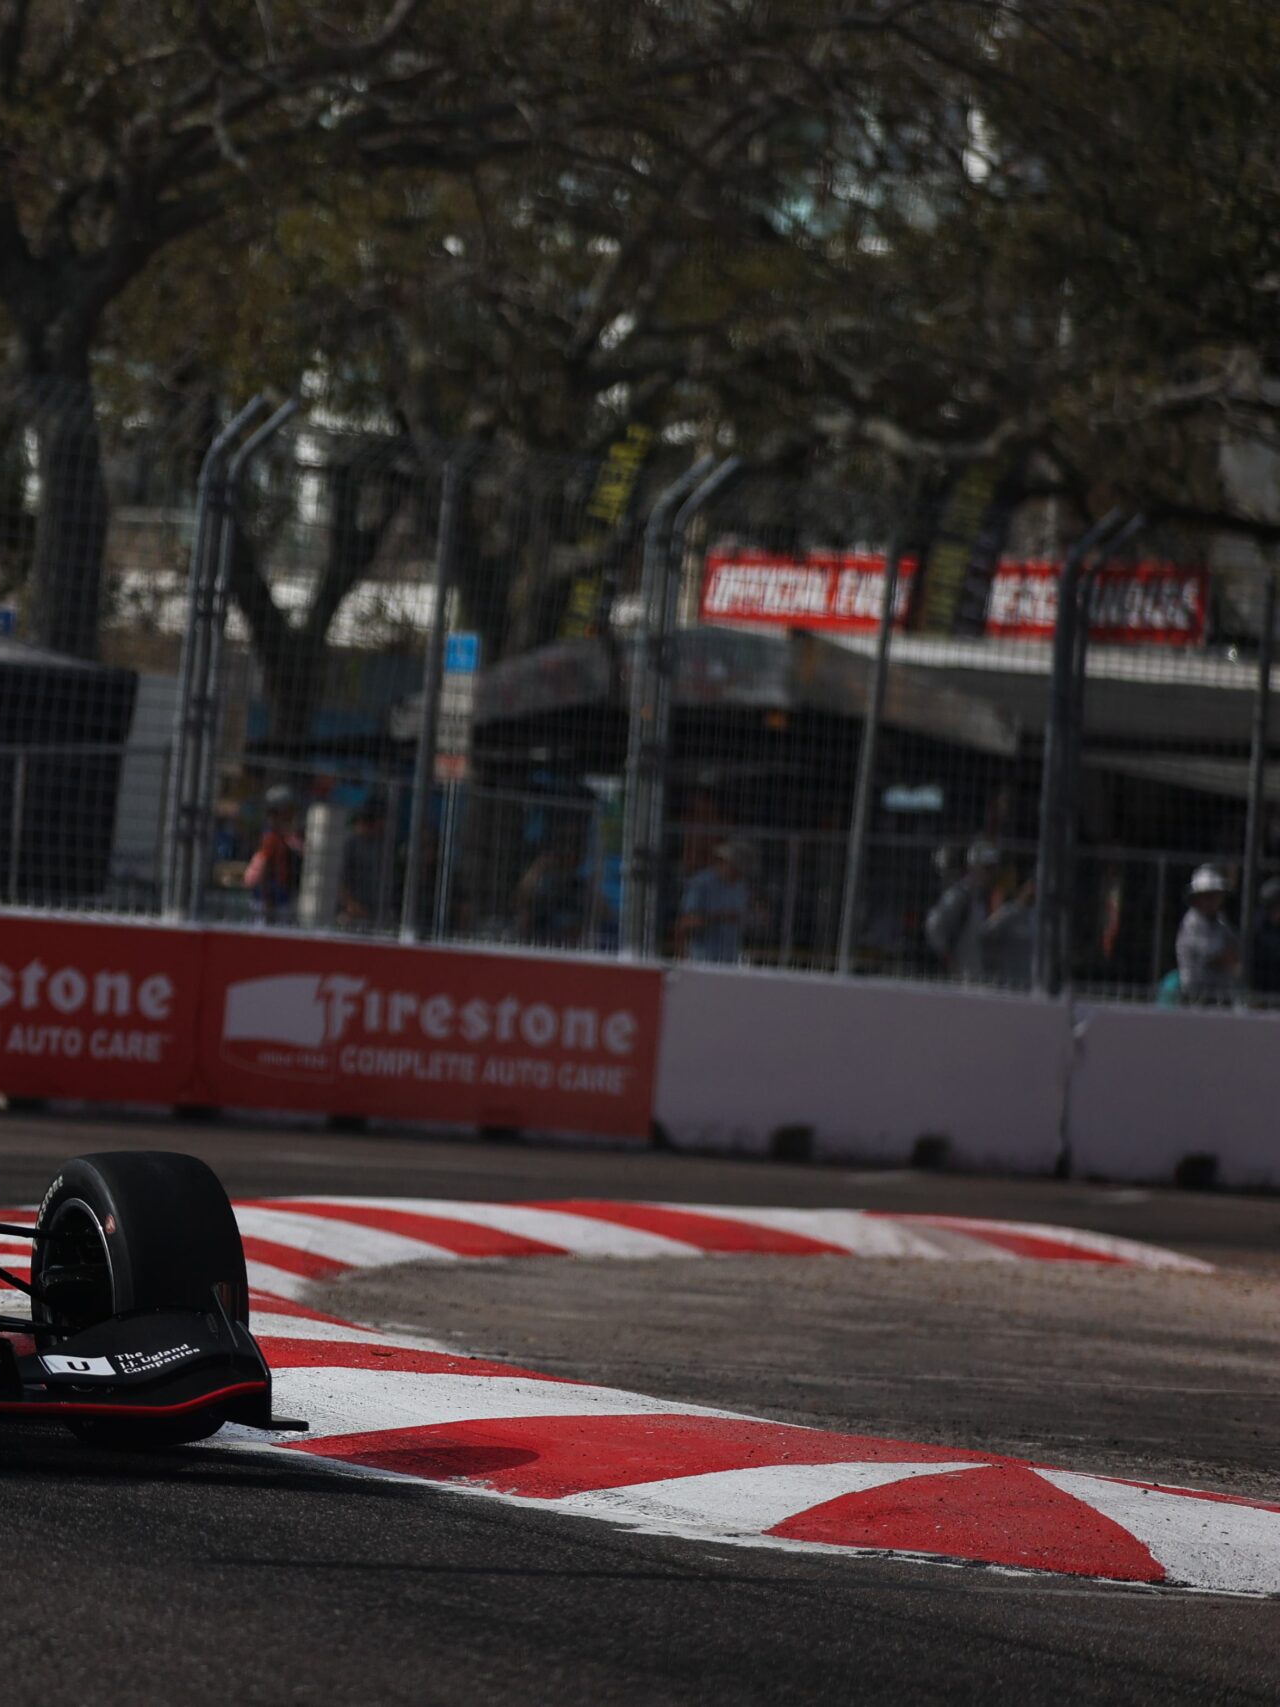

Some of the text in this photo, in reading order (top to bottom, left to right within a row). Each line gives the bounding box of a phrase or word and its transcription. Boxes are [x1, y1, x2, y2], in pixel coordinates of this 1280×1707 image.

[323, 973, 639, 1055] Firestone
[4, 1023, 82, 1060] AUTO
[340, 1044, 476, 1082] COMPLETE
[485, 1056, 551, 1091] AUTO
[114, 1351, 143, 1362] The
[123, 1347, 201, 1374] Companies
[141, 1343, 190, 1364] Ugland
